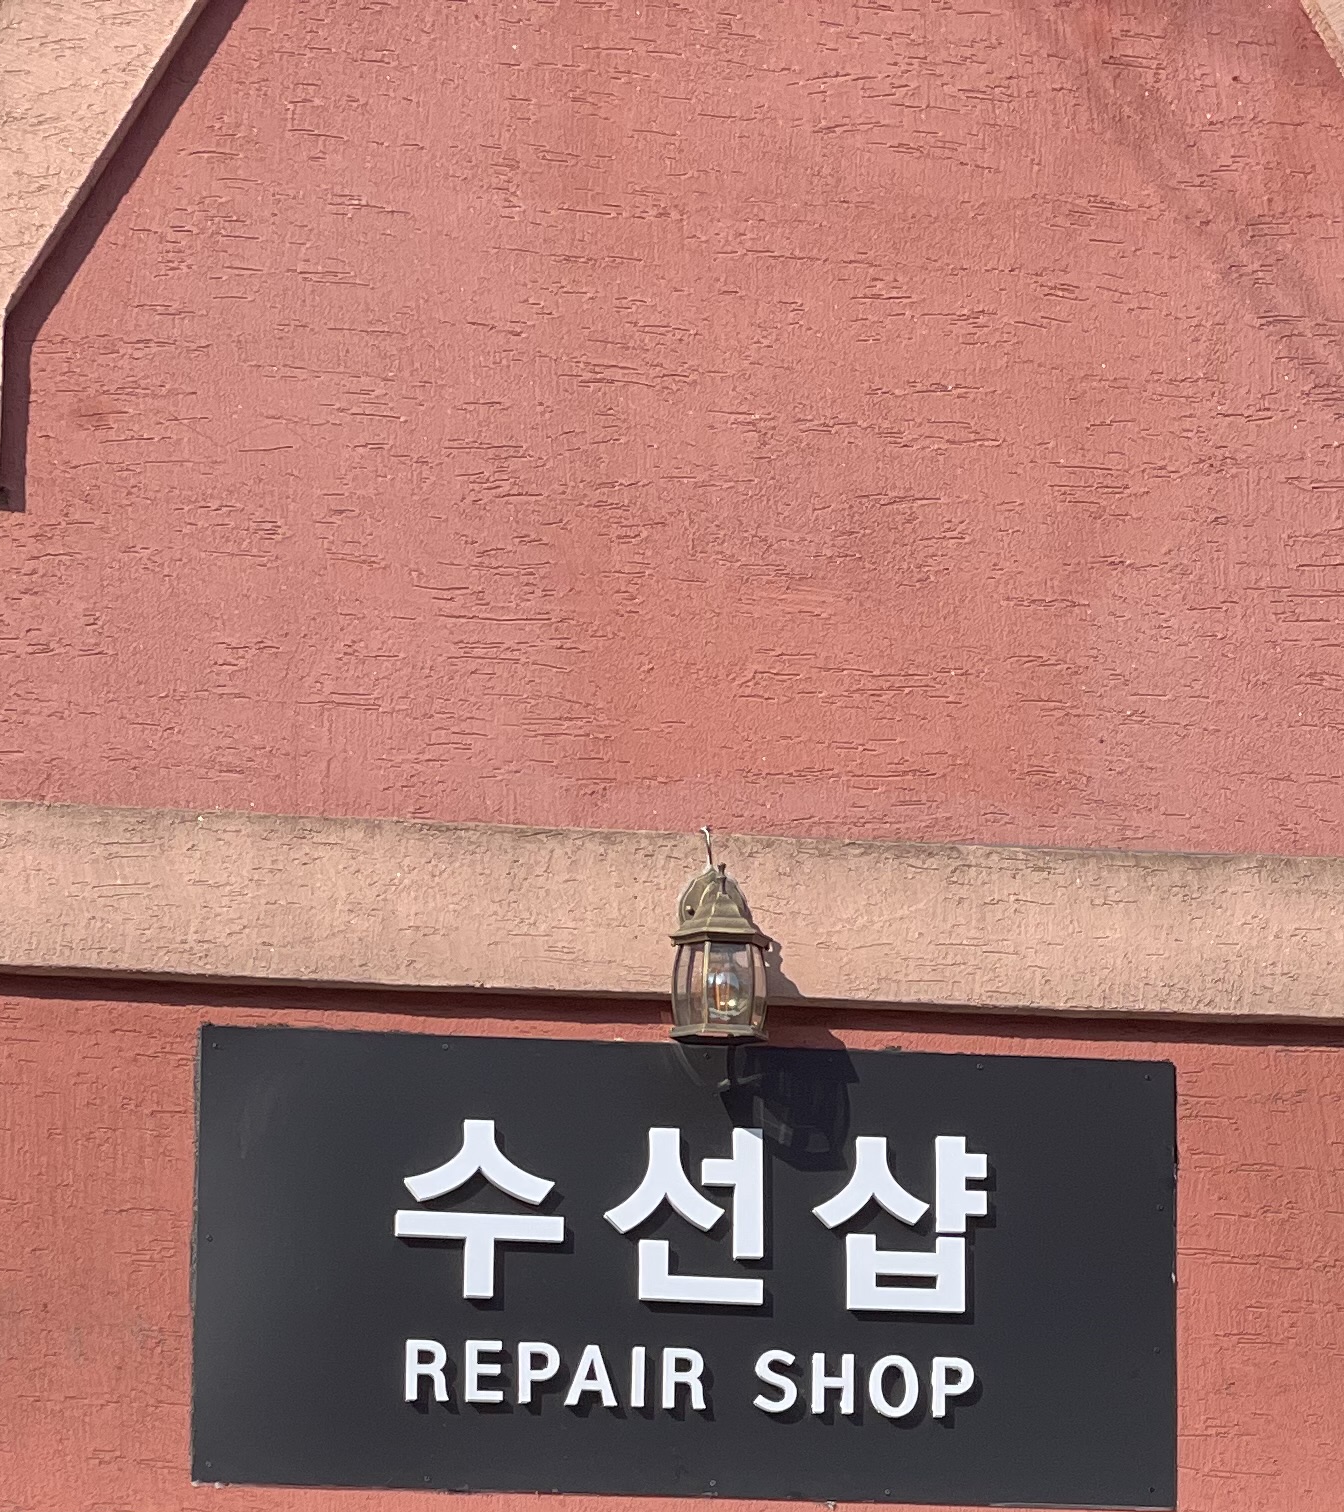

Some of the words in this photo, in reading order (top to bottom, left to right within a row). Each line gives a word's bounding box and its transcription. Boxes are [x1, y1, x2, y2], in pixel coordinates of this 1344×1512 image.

[393, 1117, 988, 1314] 수선샵
[403, 1338, 707, 1411] REPAIR
[752, 1348, 976, 1419] SHOP
